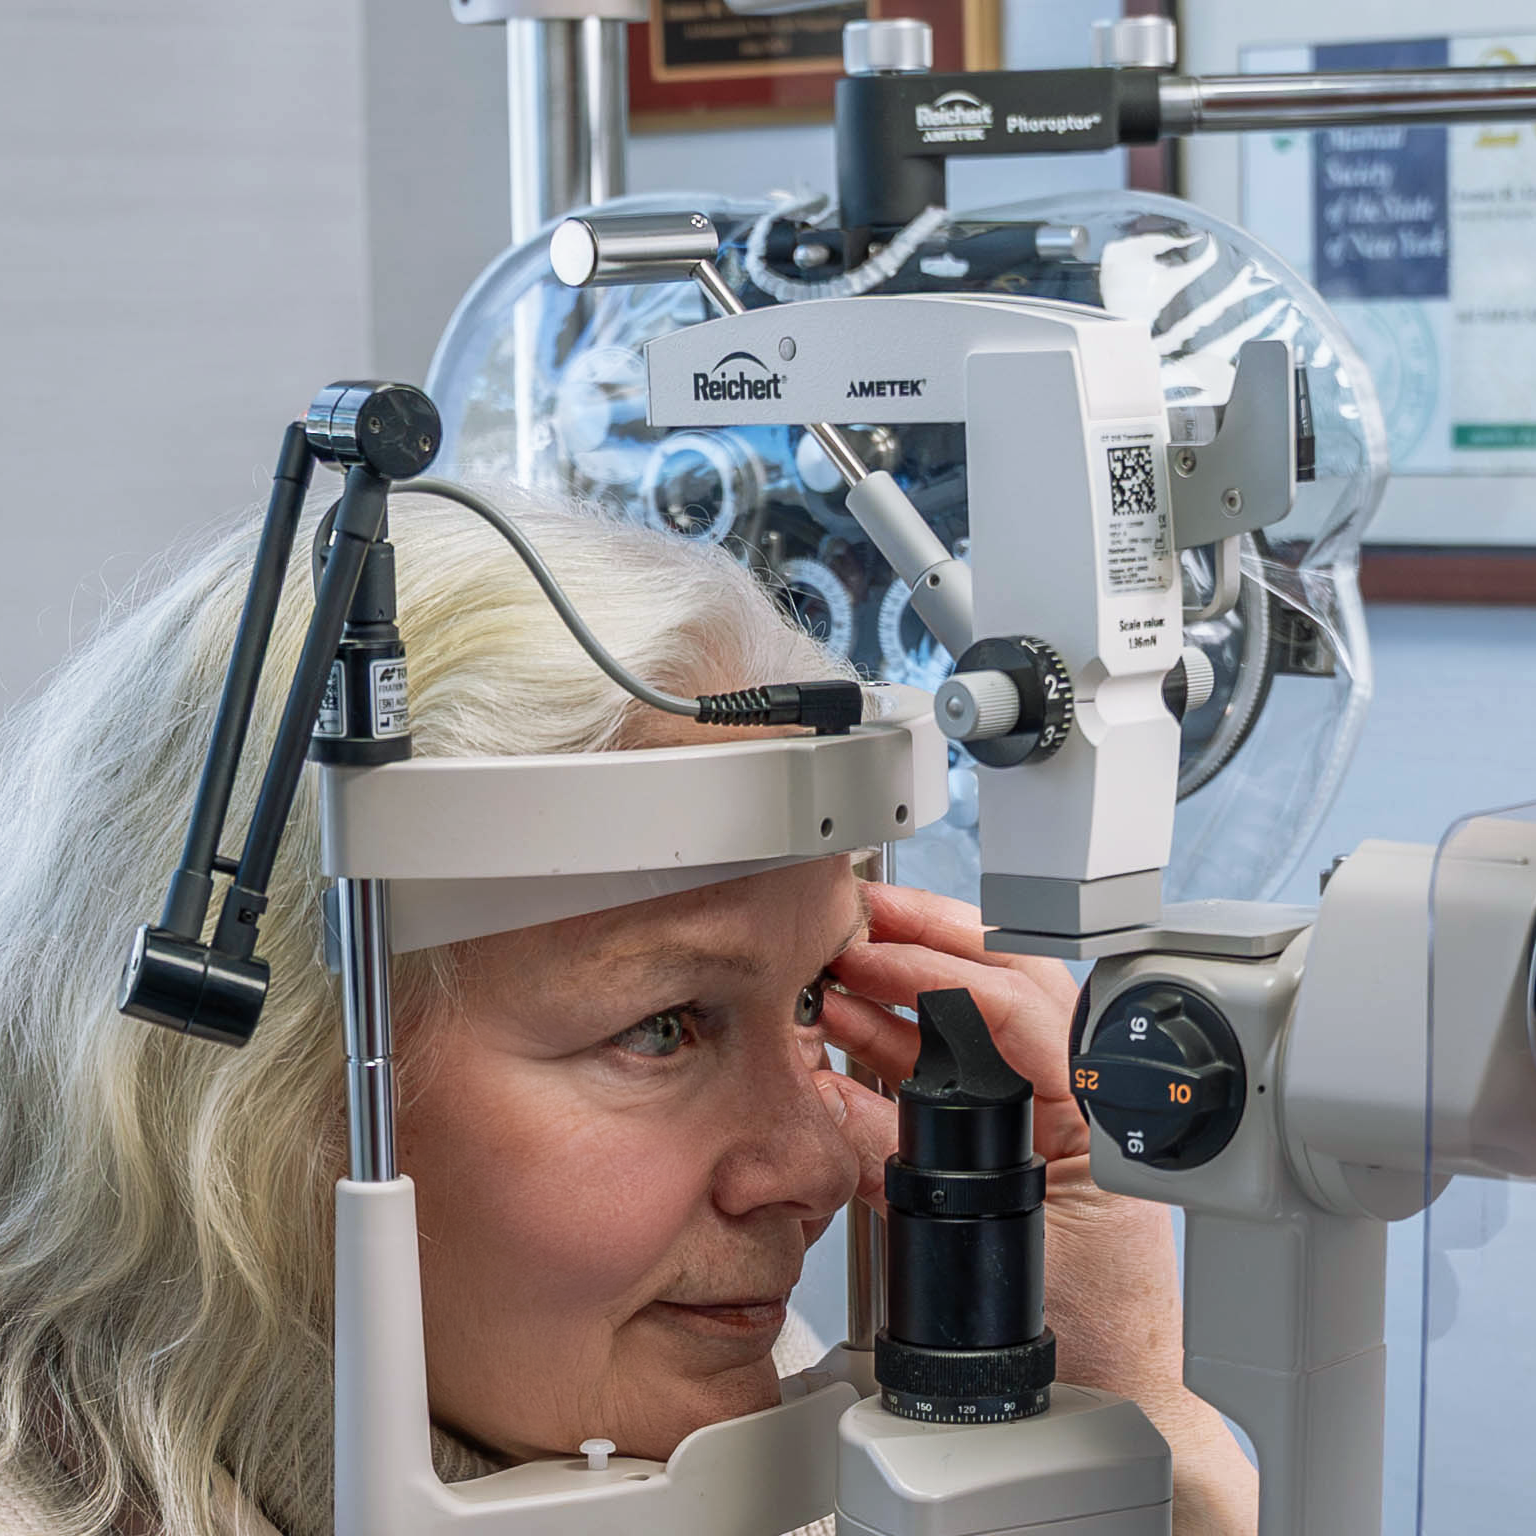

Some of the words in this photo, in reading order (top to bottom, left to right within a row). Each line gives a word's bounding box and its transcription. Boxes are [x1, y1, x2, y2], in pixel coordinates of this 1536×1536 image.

[915, 104, 993, 127] Reichert
[922, 130, 985, 143] AMETEK
[693, 371, 782, 401] Reichert
[846, 380, 922, 398] AMETEK
[1119, 619, 1141, 633] Scale
[1044, 673, 1060, 700] 2
[1039, 724, 1056, 747] 3
[1129, 1015, 1148, 1042] 16
[1075, 1067, 1100, 1090] 25
[1167, 1082, 1192, 1105] 10
[1126, 1129, 1145, 1154] 16
[915, 1401, 933, 1412] 150
[957, 1405, 977, 1415] 120
[1003, 1401, 1016, 1412] 90
